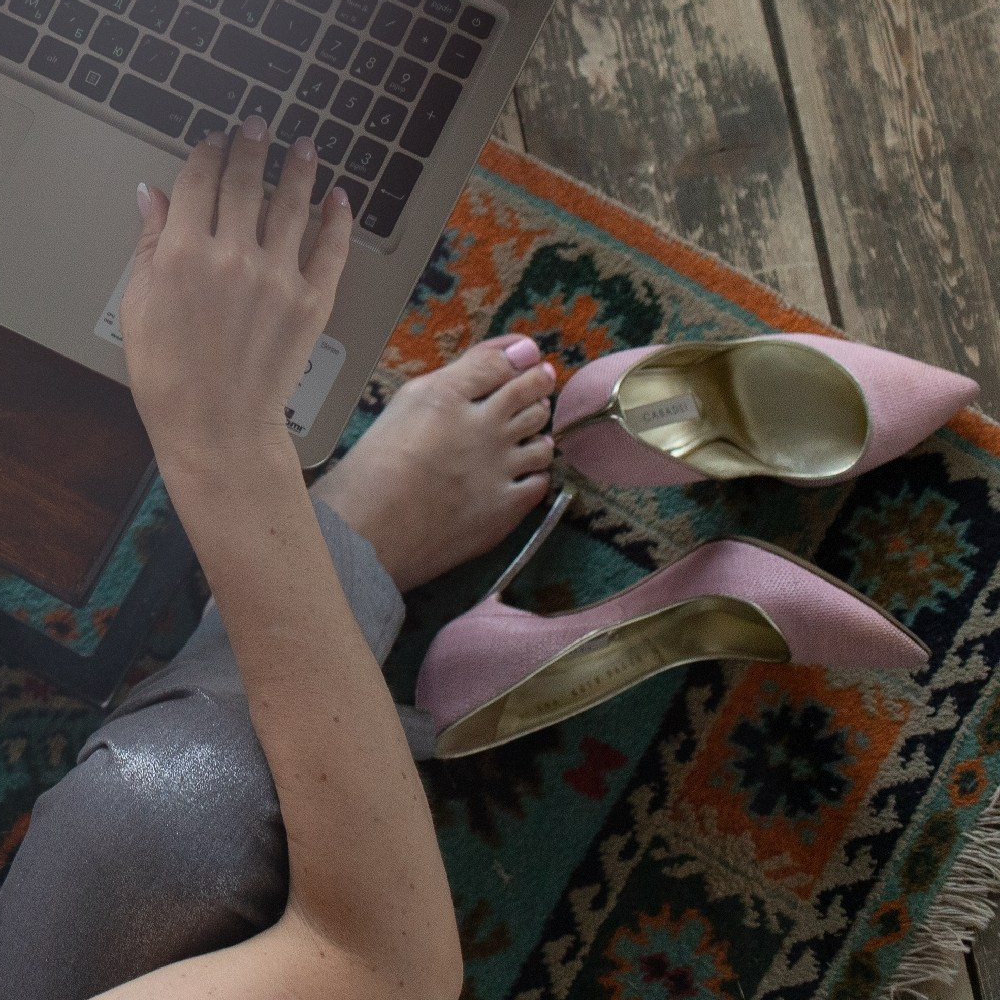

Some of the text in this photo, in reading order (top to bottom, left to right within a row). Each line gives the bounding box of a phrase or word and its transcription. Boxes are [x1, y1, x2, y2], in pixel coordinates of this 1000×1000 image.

[331, 40, 342, 51] 7
[365, 56, 376, 69] 8
[400, 73, 411, 84] 9
[311, 82, 323, 92] 4
[345, 96, 357, 109] 5
[380, 113, 392, 125] 6
[293, 120, 302, 131] 1
[326, 136, 337, 149] 2
[360, 152, 372, 165] 3
